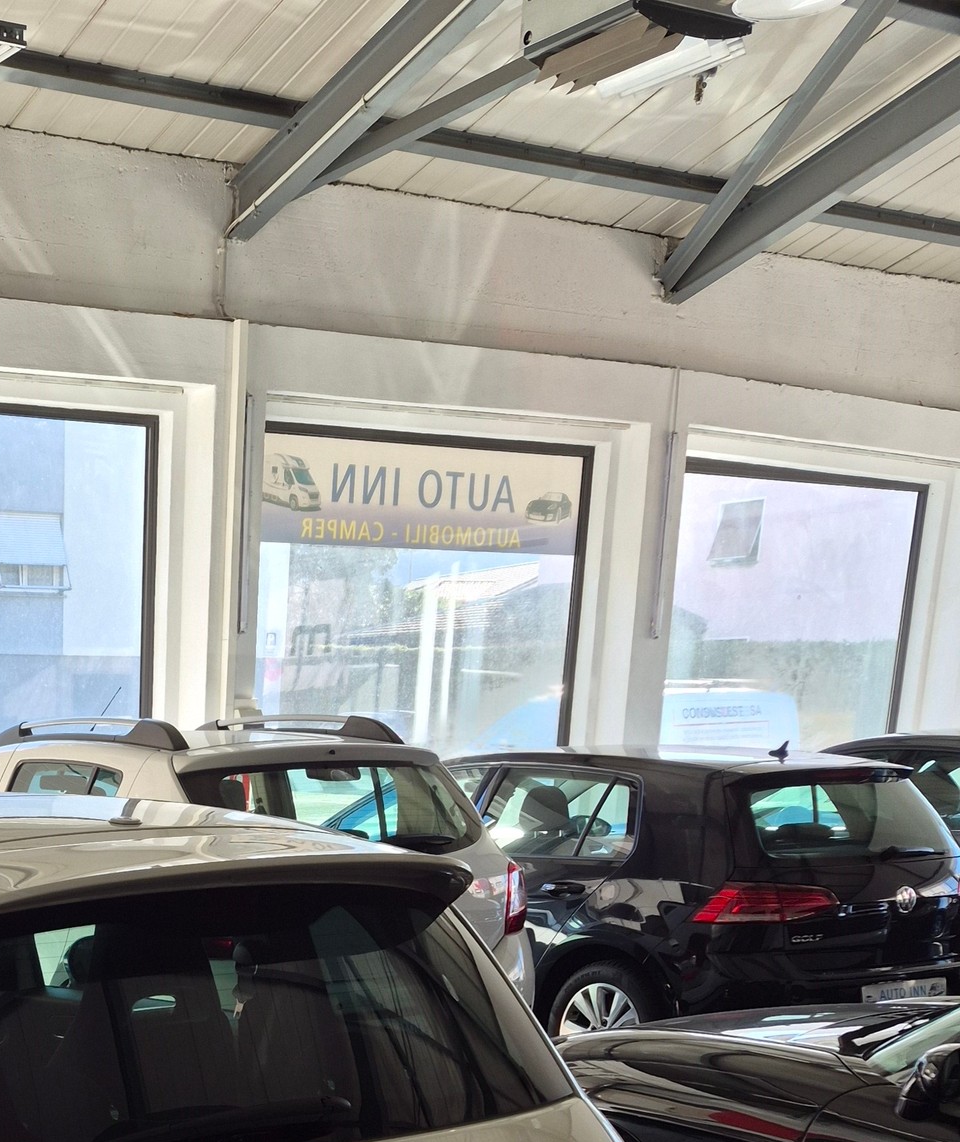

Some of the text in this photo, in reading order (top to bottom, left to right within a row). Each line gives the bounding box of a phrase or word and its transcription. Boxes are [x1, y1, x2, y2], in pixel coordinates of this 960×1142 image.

[791, 934, 824, 943] GOLF
[879, 985, 927, 1000] AUTO INN
